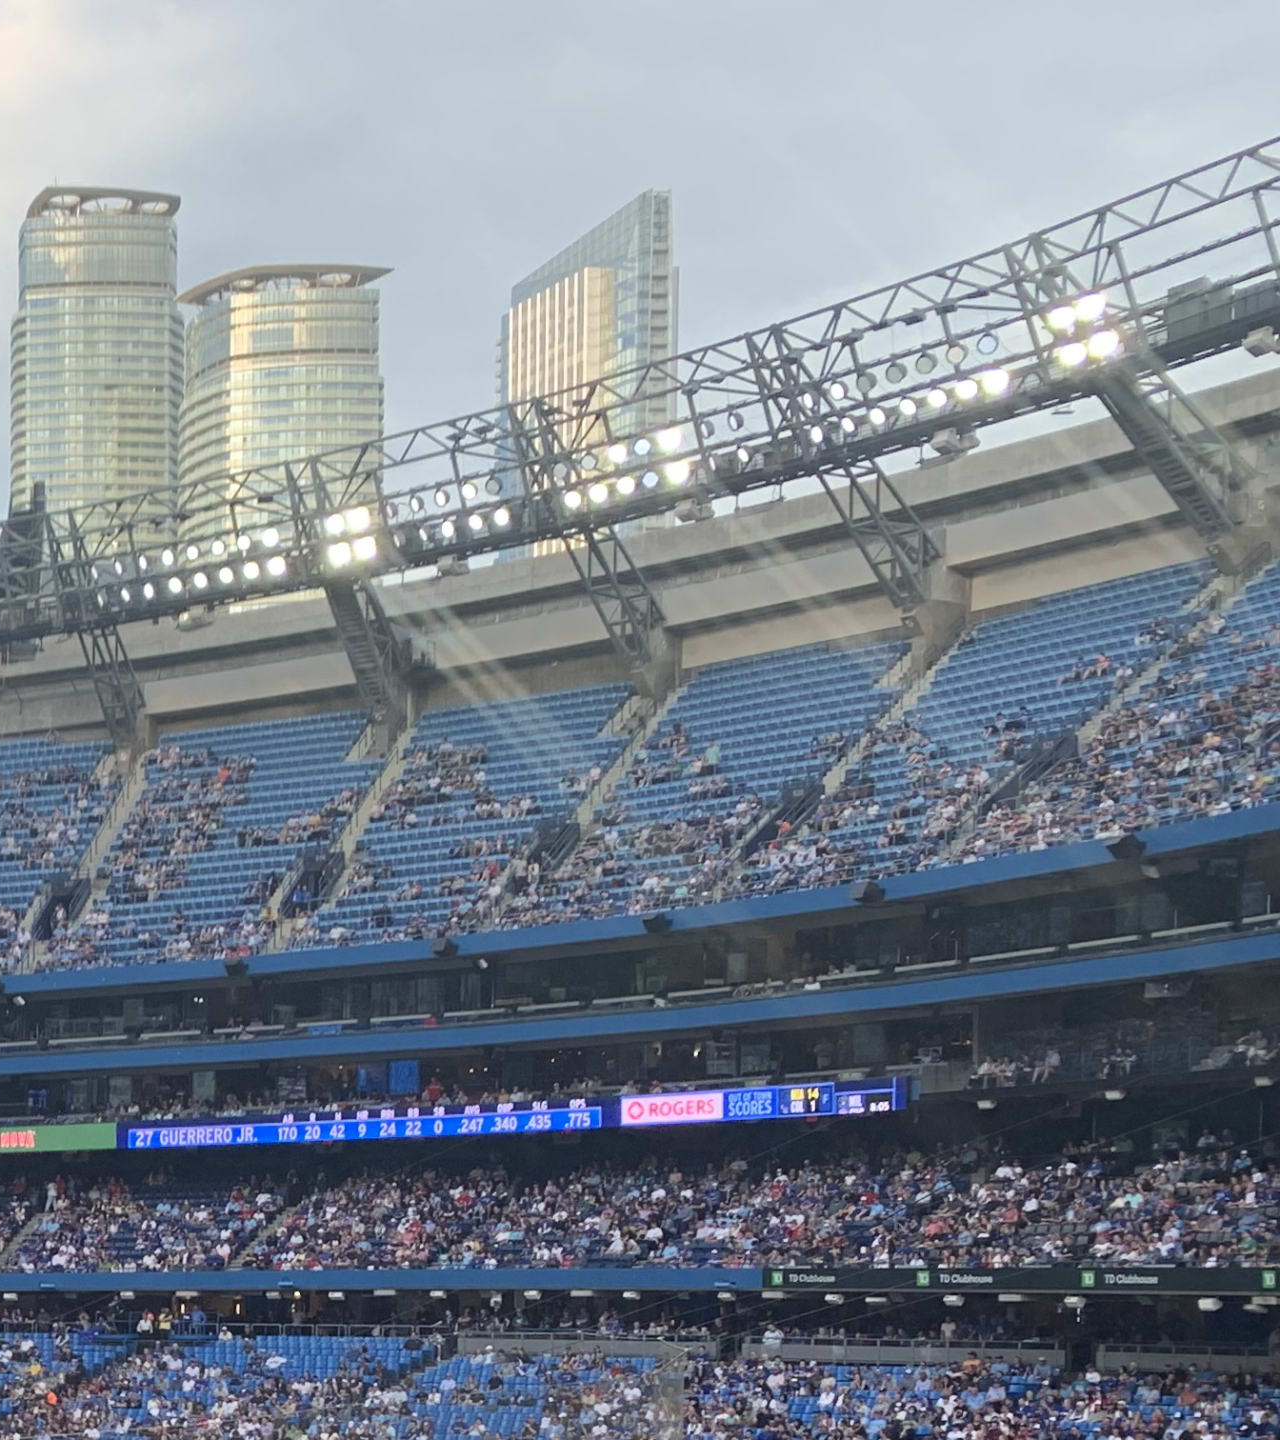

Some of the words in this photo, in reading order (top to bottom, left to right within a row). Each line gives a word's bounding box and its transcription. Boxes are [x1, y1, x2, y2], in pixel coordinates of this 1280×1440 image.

[728, 1093, 743, 1101] OUT
[753, 1091, 772, 1100] TOWN
[807, 1088, 819, 1100] 14
[649, 1099, 715, 1116] ROGERS
[728, 1098, 773, 1117] SCORES
[135, 1132, 153, 1147] 27
[159, 1128, 233, 1146] GUERRERO
[236, 1127, 258, 1143] JR.
[277, 1127, 297, 1141] 170
[304, 1125, 321, 1140] 20
[329, 1124, 346, 1139] 42
[358, 1123, 367, 1138] 9
[379, 1122, 397, 1137] 24
[405, 1121, 422, 1136] 22
[433, 1120, 443, 1135] 0
[457, 1118, 484, 1133] .247
[491, 1116, 517, 1131] .340
[525, 1115, 552, 1130] .435
[564, 1112, 591, 1127] .775
